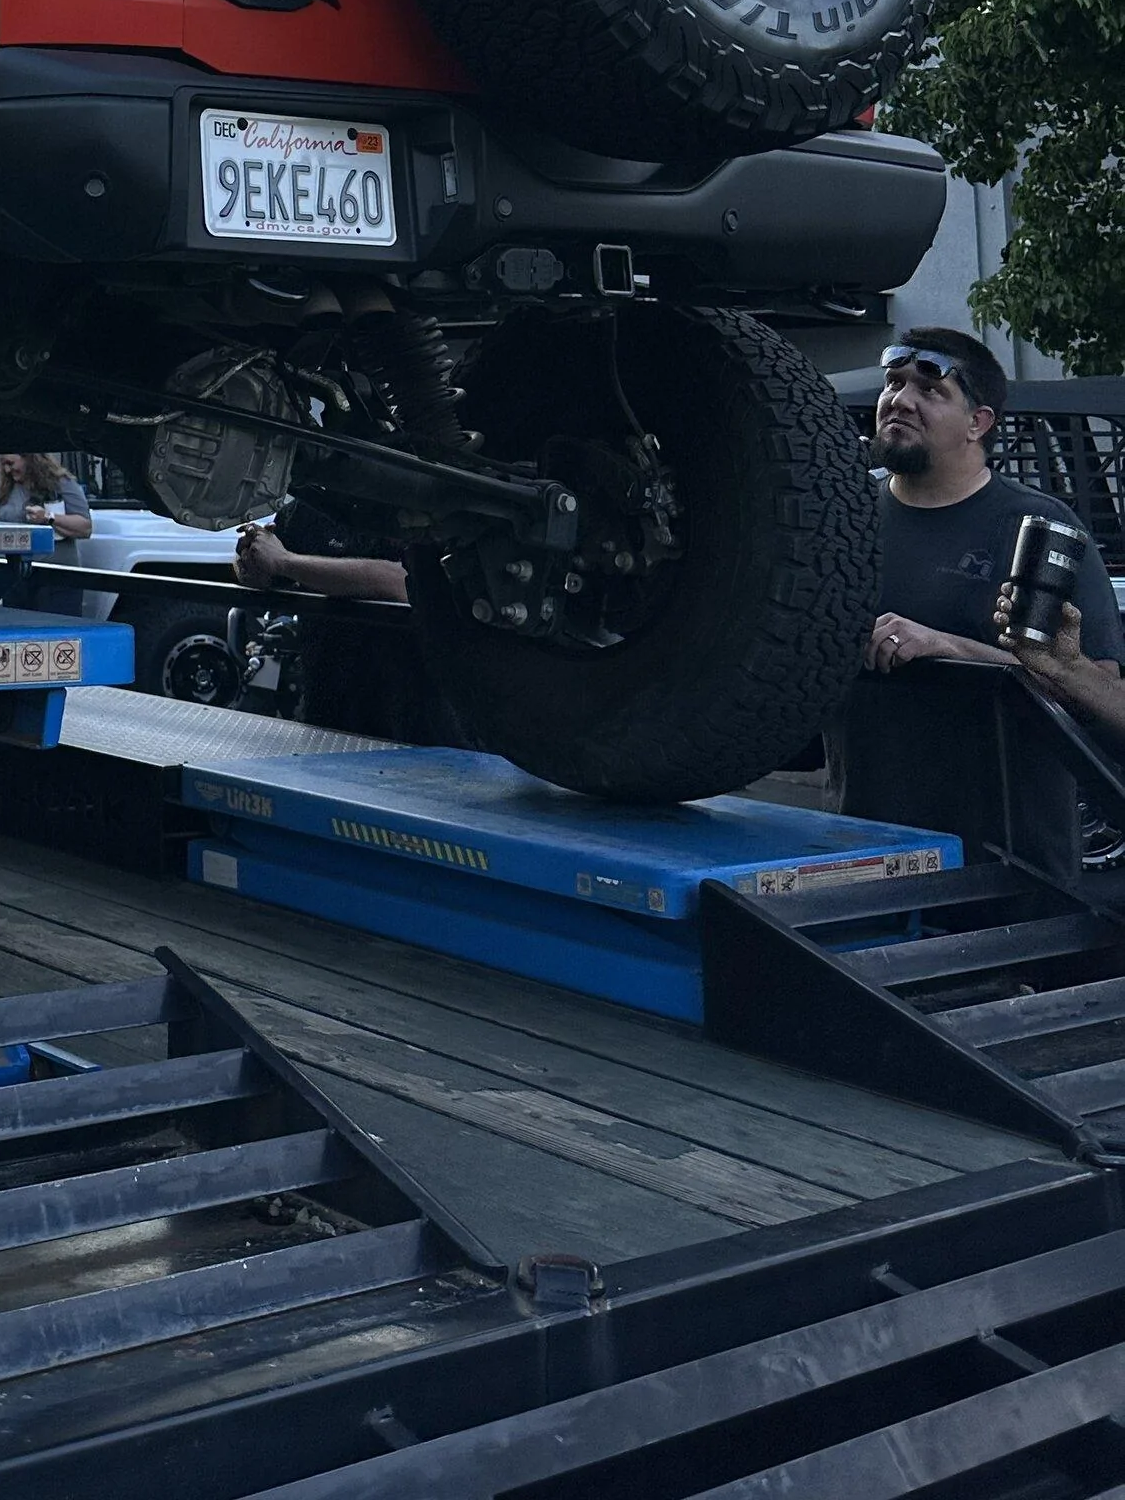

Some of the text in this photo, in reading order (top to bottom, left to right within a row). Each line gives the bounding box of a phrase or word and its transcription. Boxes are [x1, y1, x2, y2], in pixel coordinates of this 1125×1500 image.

[214, 121, 236, 138] DEC
[243, 121, 358, 159] California
[218, 160, 383, 225] 9EKE460
[255, 221, 351, 235] dmv.ca.gov
